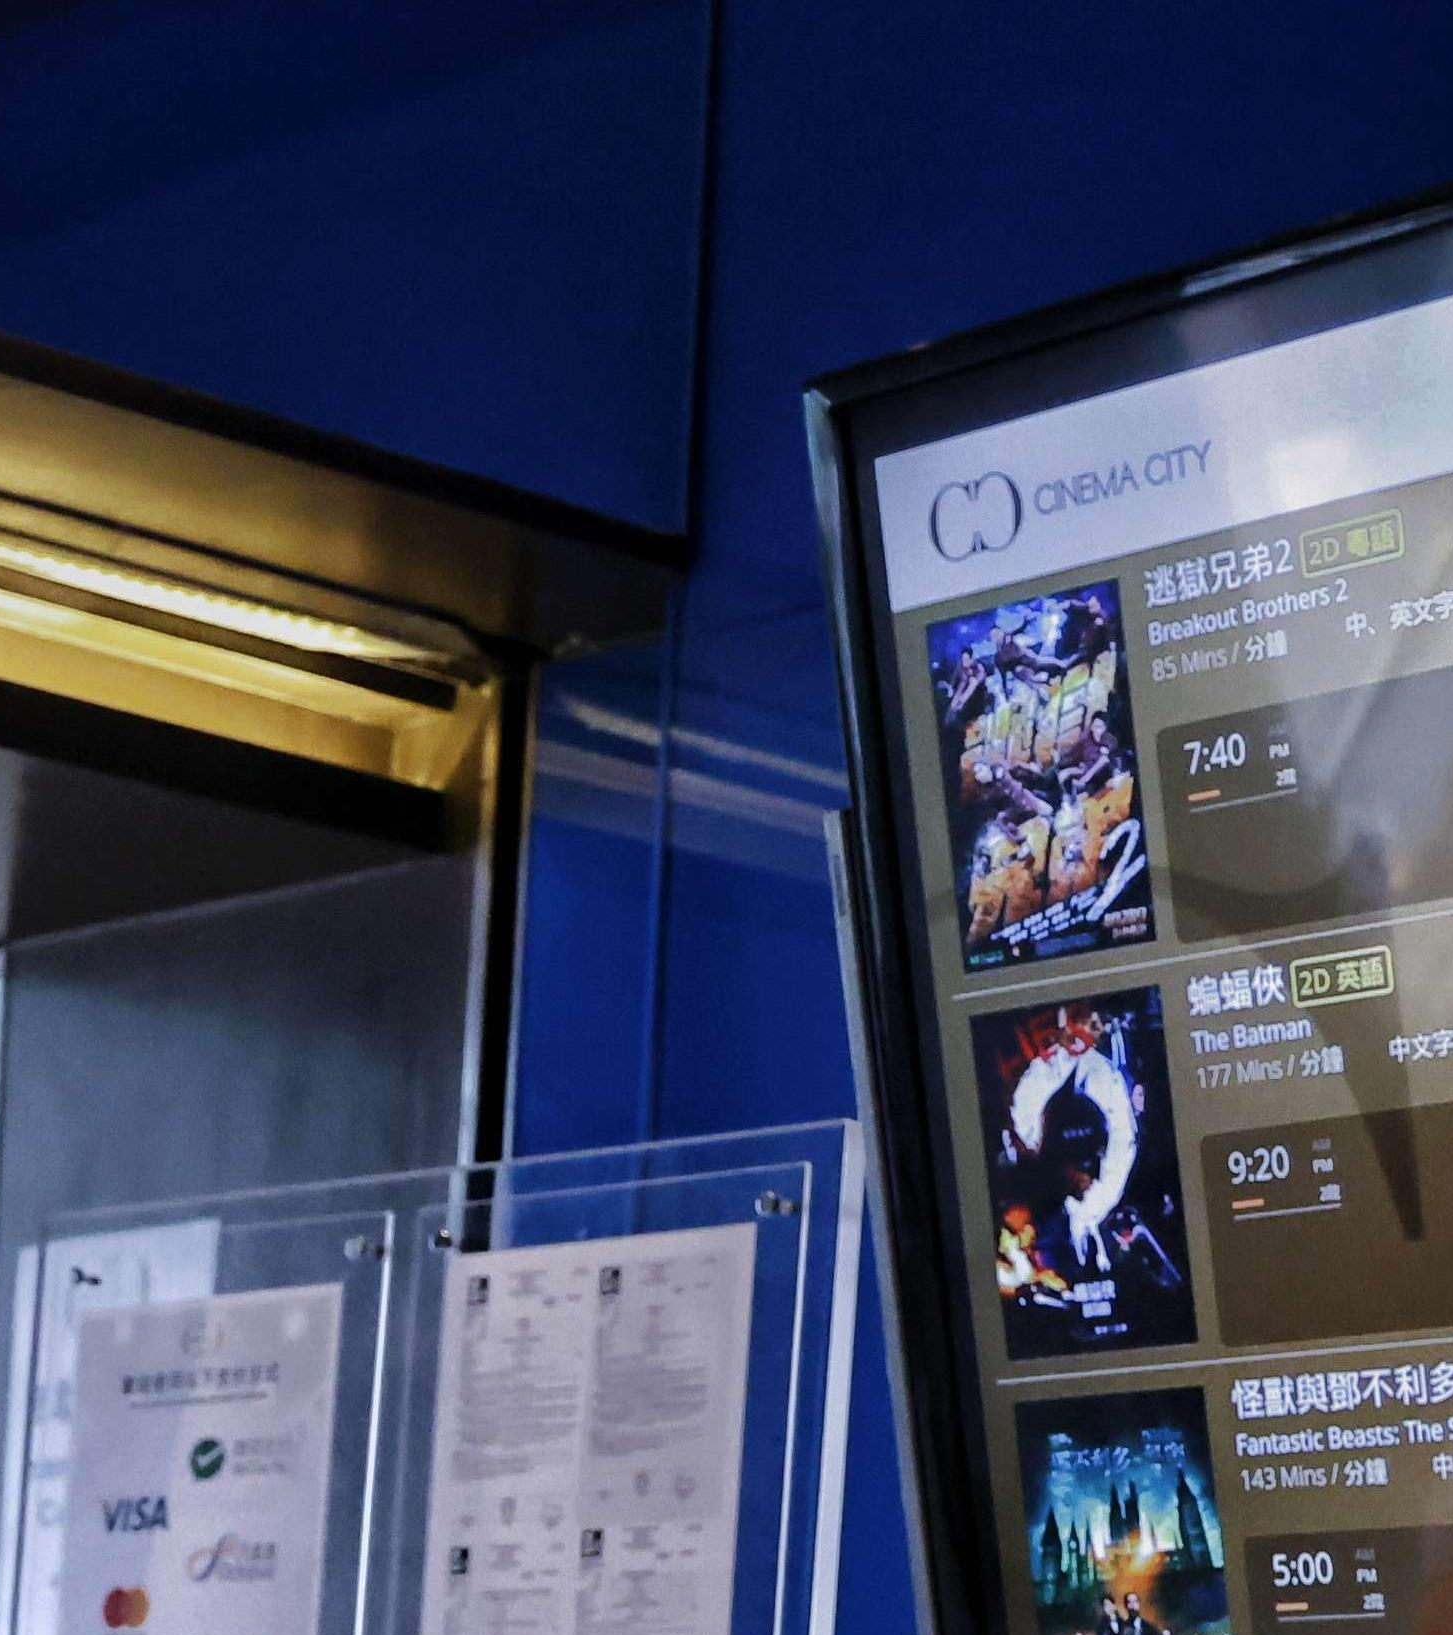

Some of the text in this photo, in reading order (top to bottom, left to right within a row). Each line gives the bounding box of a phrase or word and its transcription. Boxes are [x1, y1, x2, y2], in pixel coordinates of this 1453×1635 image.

[1033, 439, 1213, 515] CINEMA CITY
[1144, 539, 1294, 608] 逃獄兄弟2
[1308, 537, 1341, 566] 2D
[1147, 577, 1350, 647] Breakout Brothers 2
[1150, 656, 1177, 683] 85
[1180, 645, 1228, 675] Mins
[1230, 641, 1240, 666] /
[1183, 733, 1246, 775] 7:40
[1187, 956, 1386, 1017] 蝙蝠俠 2D 英語
[1190, 1017, 1312, 1055] The Batman
[1196, 1062, 1232, 1089] 177
[1236, 1056, 1284, 1085] Mins
[1227, 1144, 1291, 1186] 9:20
[1235, 1429, 1325, 1458] Fantastic
[1327, 1422, 1401, 1451] Beasts:
[1402, 1418, 1444, 1444] The
[1240, 1468, 1277, 1492] 143
[1280, 1463, 1328, 1488] Mins
[102, 1495, 169, 1532] VISA
[1271, 1551, 1334, 1587] 5:00
